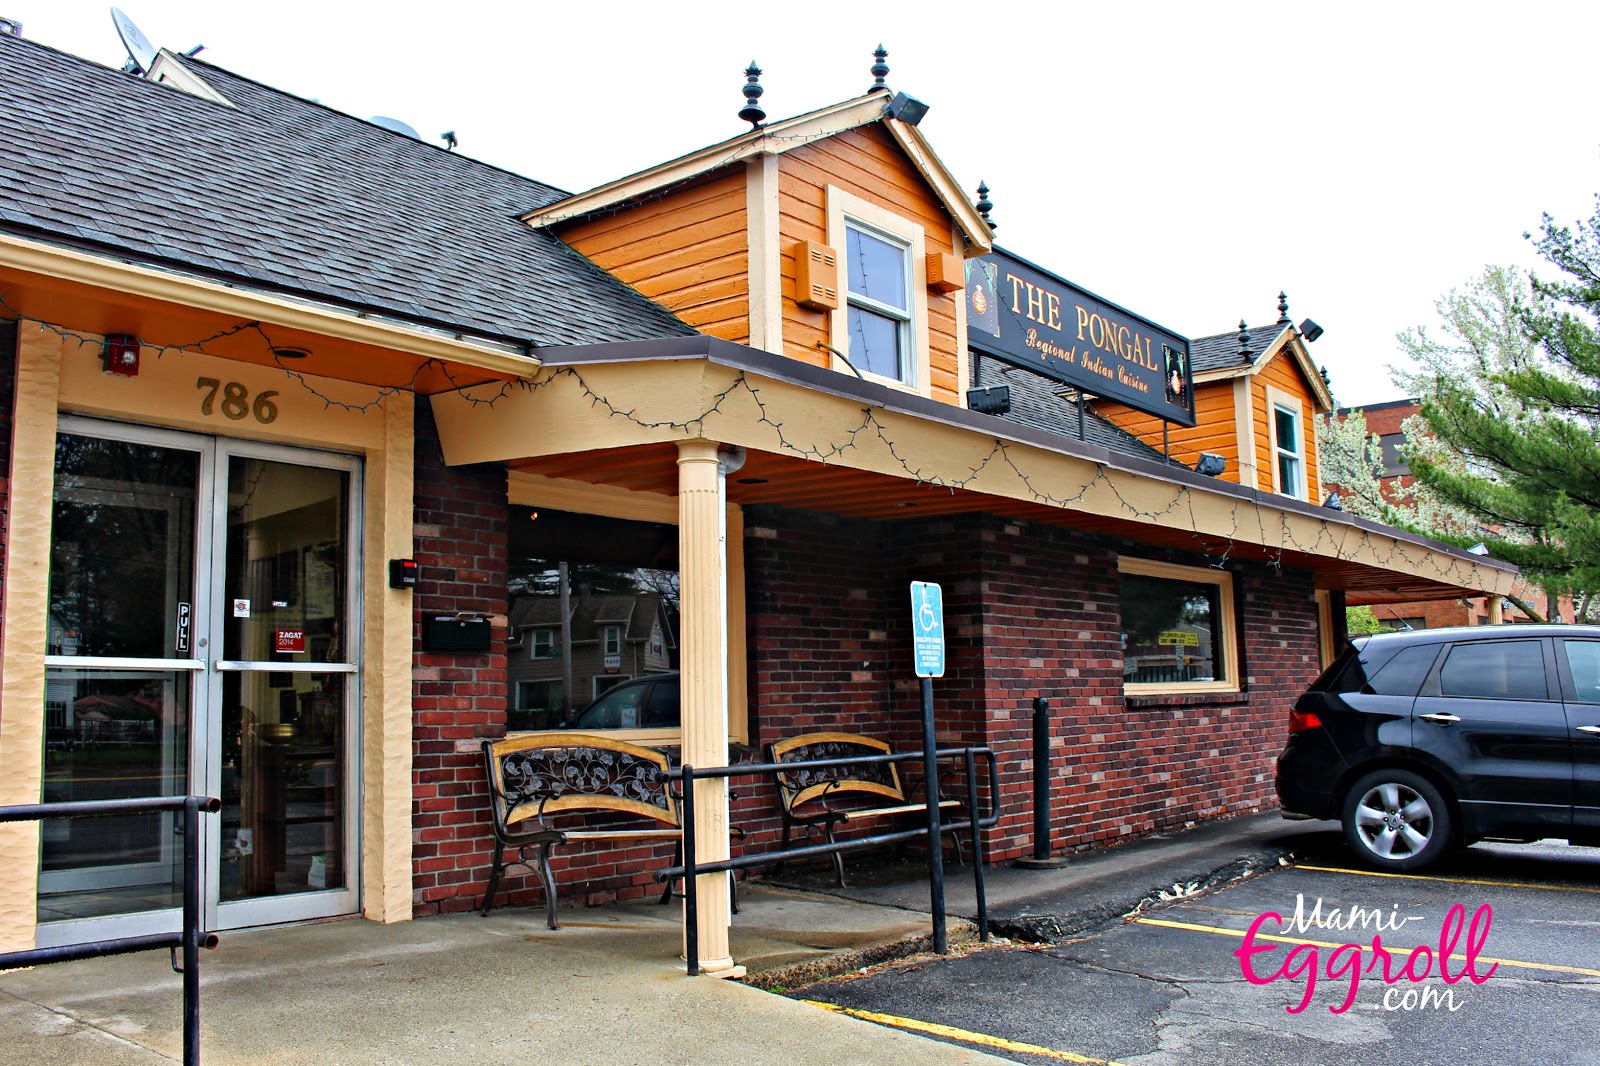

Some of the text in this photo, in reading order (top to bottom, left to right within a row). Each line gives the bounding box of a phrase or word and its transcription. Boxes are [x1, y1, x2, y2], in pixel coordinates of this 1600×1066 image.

[1006, 272, 1159, 372] THE PONGAL
[1025, 328, 1149, 393] Regional Indian Cuisine
[197, 376, 280, 424] 786
[179, 605, 189, 649] PULL
[279, 631, 302, 639] ZAGAT
